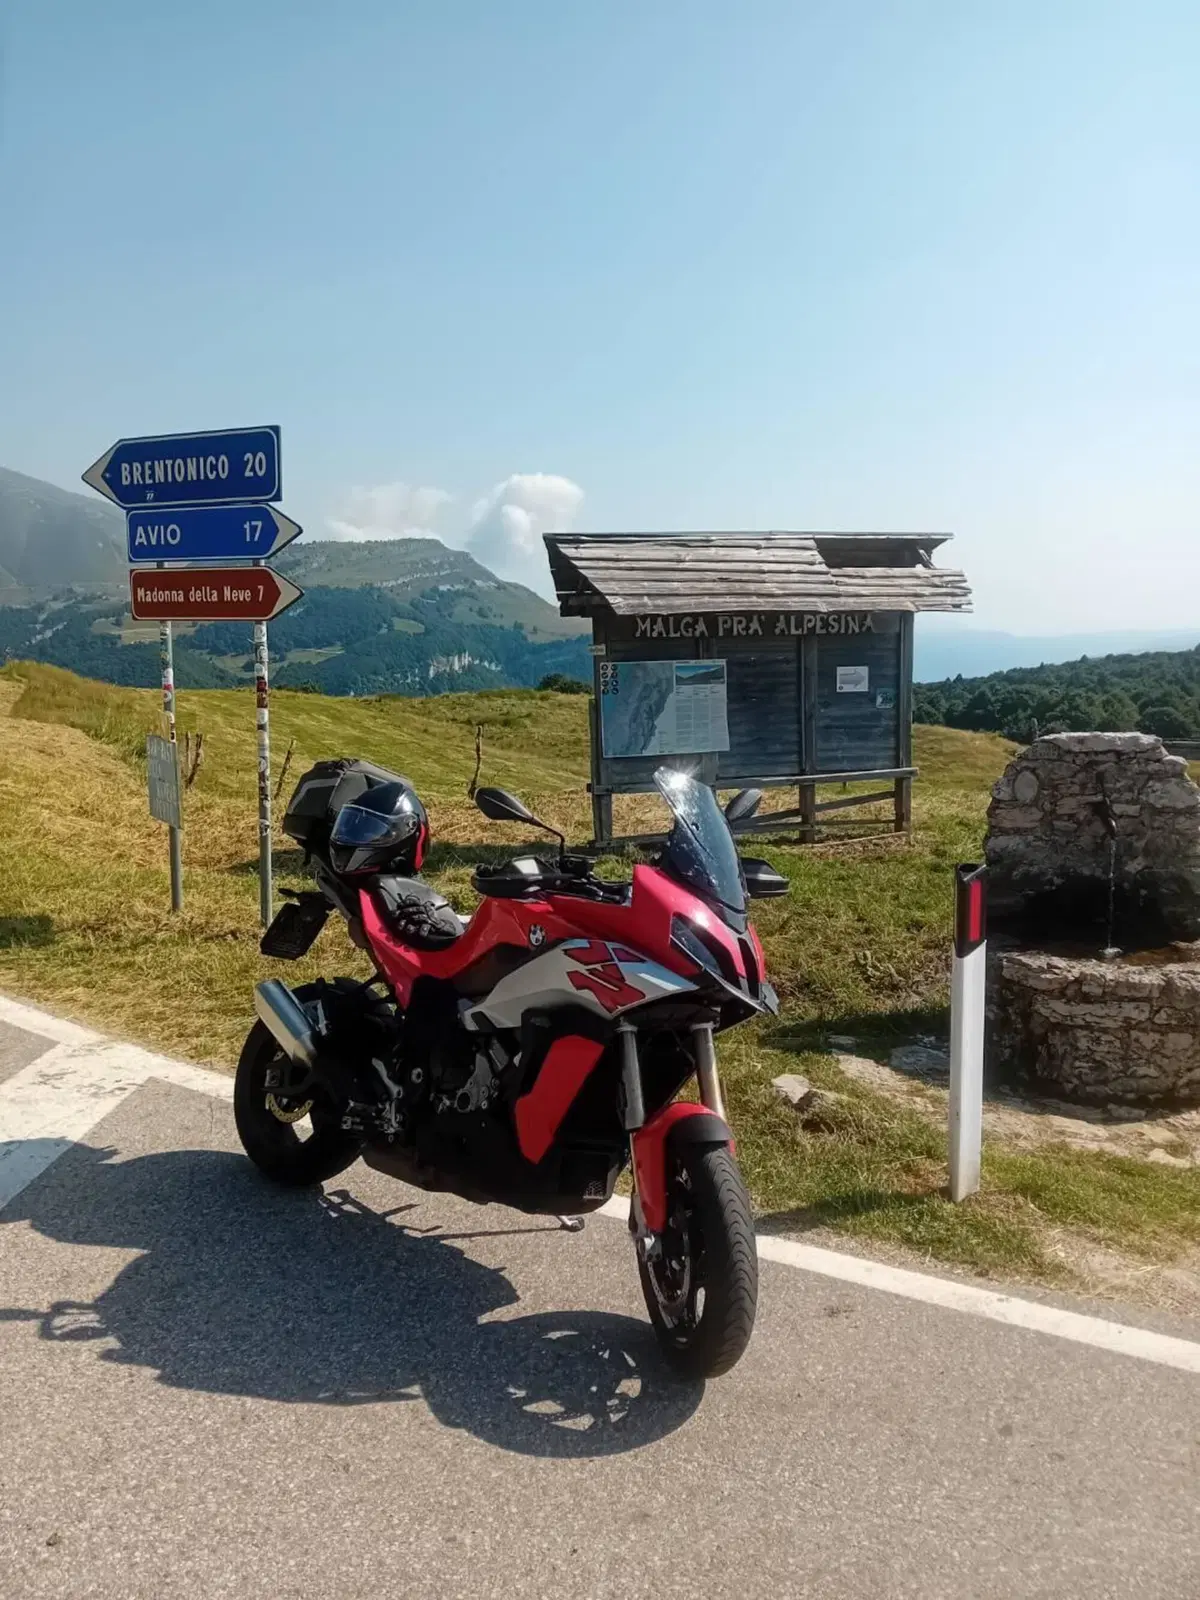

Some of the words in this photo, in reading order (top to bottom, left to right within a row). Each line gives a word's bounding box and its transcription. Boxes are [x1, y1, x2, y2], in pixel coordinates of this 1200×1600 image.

[121, 455, 229, 485] BRENTONICO
[243, 452, 267, 477] 20
[135, 524, 181, 546] AVIO
[243, 521, 263, 542] 17
[137, 587, 184, 602] Madonna
[189, 586, 218, 602] della
[223, 586, 251, 602] Neve
[257, 586, 264, 601] 7
[635, 615, 708, 638] MALGA
[774, 613, 876, 636] ALPESINA
